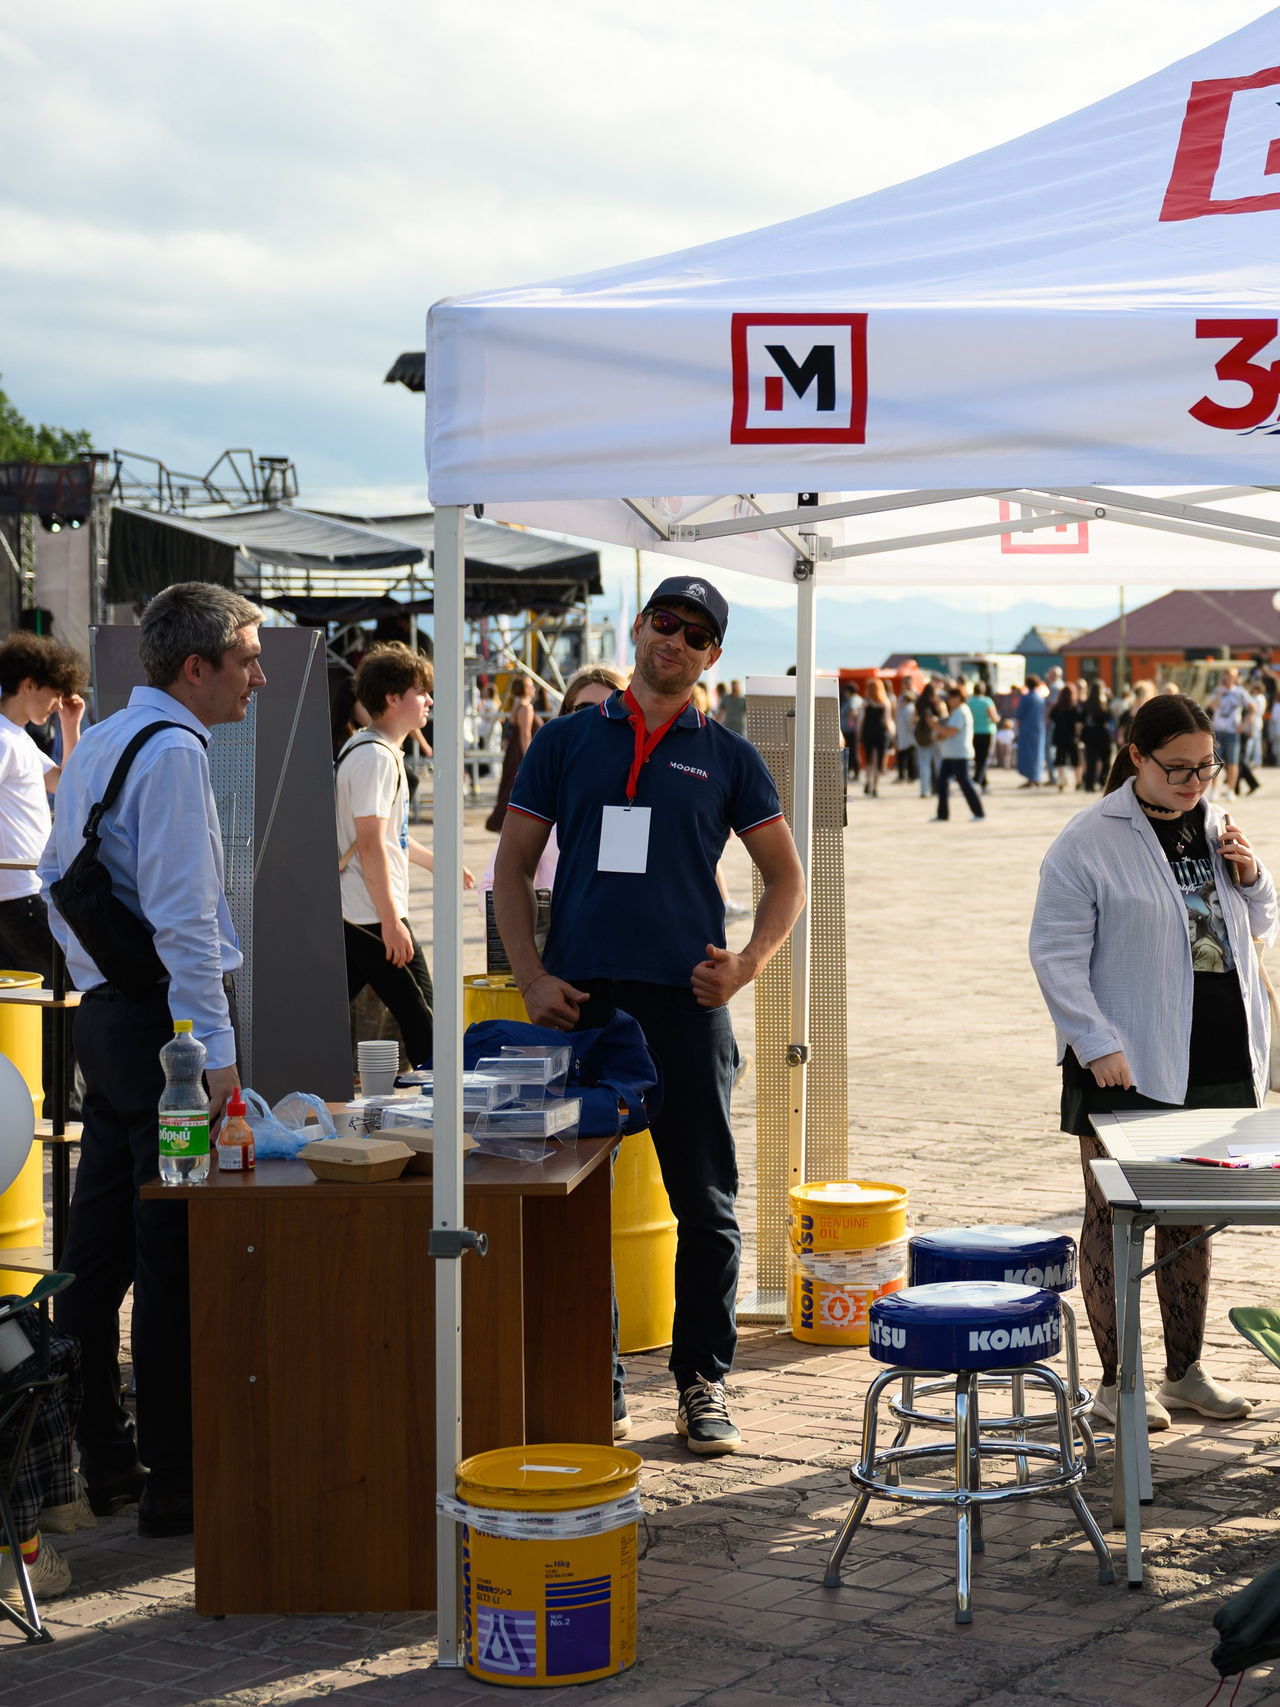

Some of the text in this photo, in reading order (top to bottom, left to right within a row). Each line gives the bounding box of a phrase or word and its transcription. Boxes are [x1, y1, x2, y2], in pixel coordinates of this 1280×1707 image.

[669, 761, 709, 779] MODERN
[820, 1217, 869, 1228] GENUINE
[820, 1228, 839, 1239] OIL
[1004, 1263, 1075, 1286] KOMA
[969, 1315, 1060, 1352] KOMATS
[550, 1619, 571, 1627] No.2
